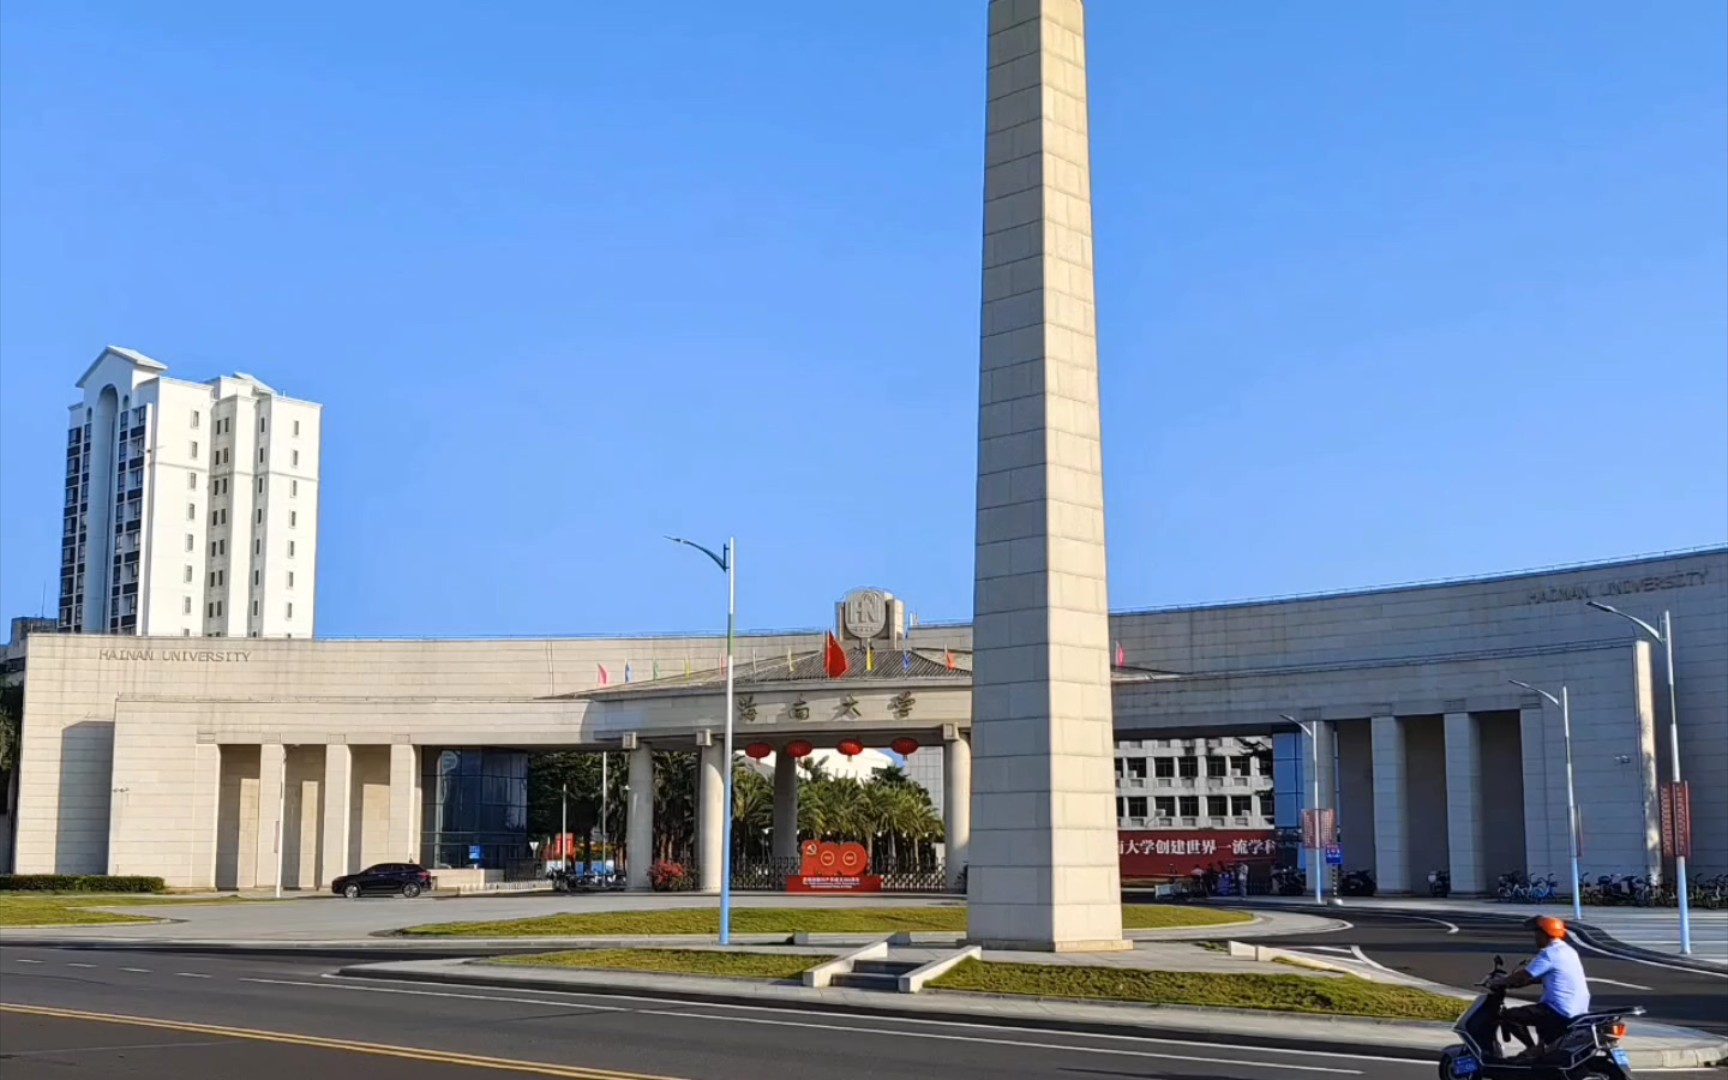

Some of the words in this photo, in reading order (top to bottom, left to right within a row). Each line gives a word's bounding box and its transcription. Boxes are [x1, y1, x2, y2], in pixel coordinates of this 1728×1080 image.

[1527, 586, 1592, 604] HAINAN
[1601, 570, 1709, 596] UNIVERSITY
[98, 649, 154, 661] HAINAN
[162, 650, 252, 662] UNIVERSITY
